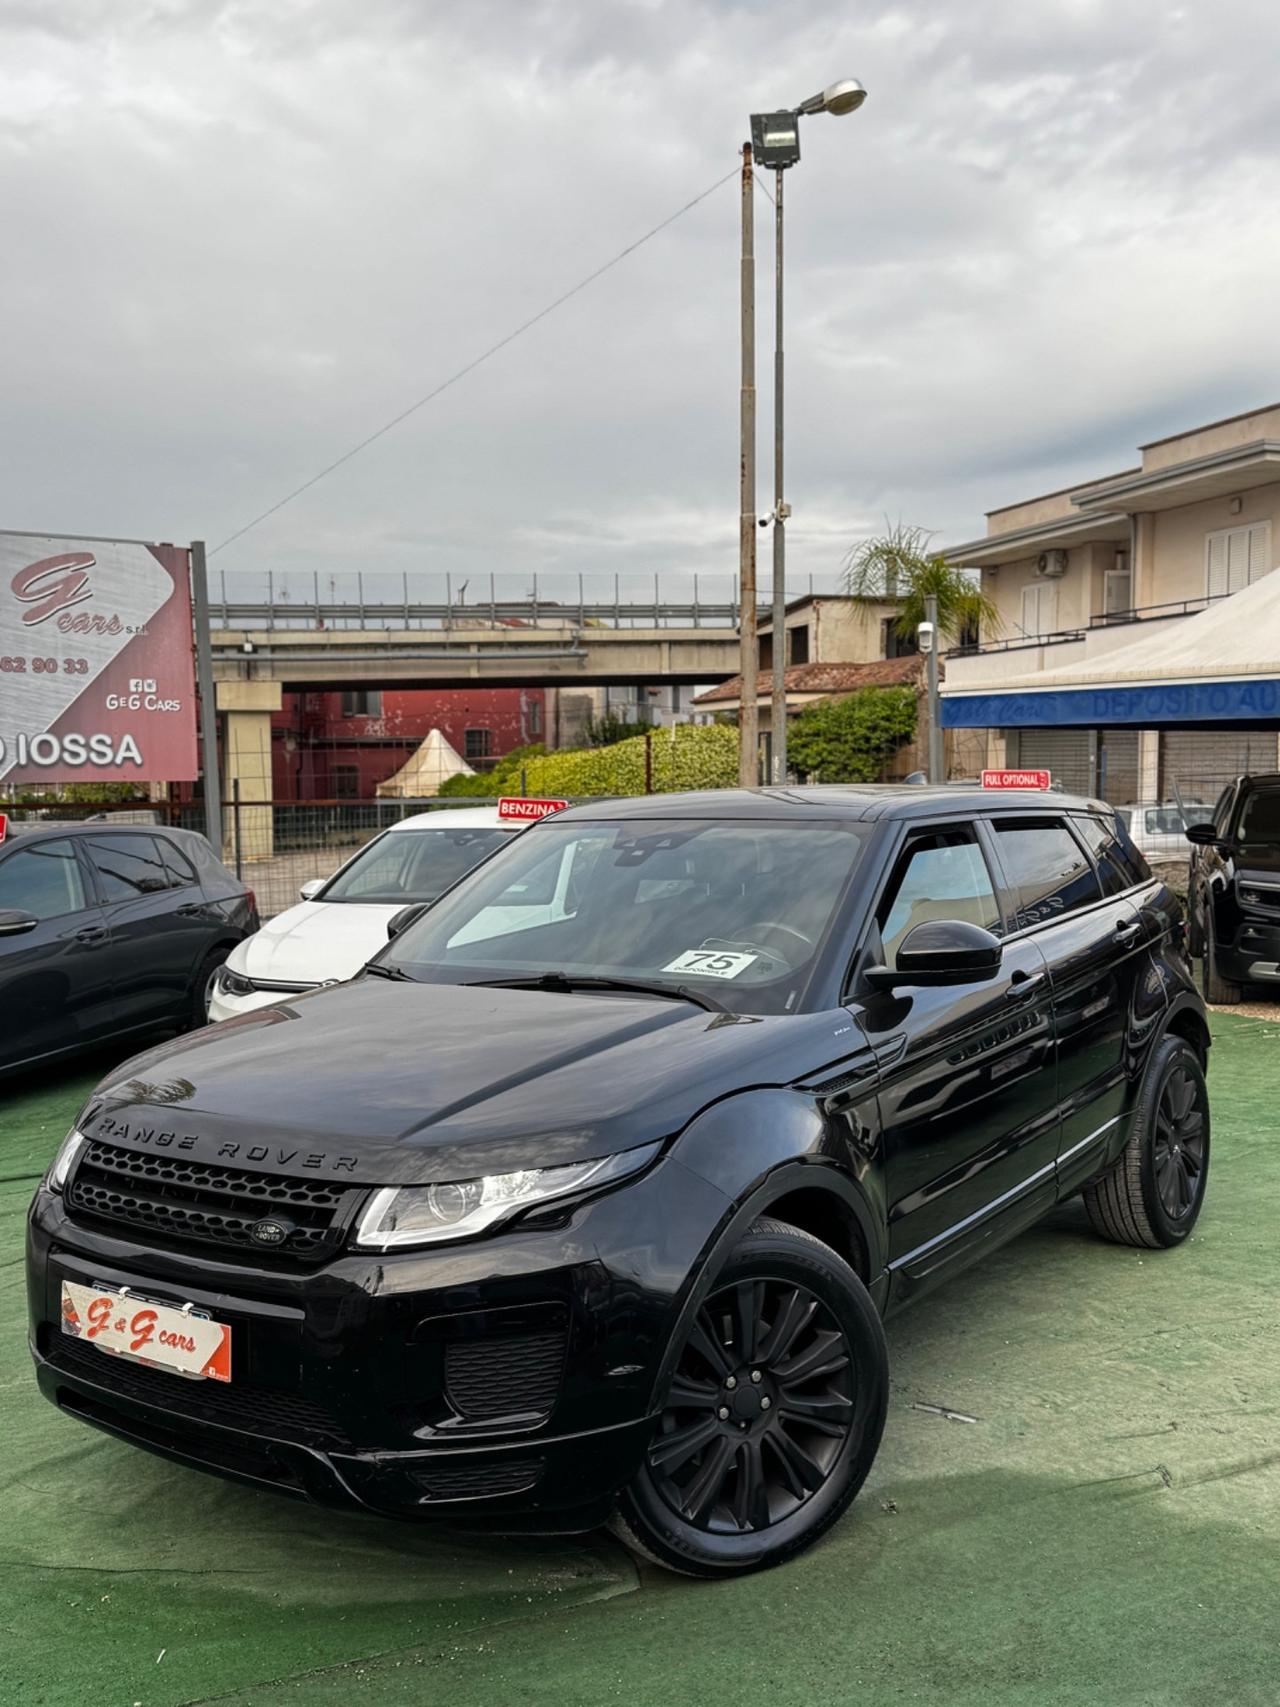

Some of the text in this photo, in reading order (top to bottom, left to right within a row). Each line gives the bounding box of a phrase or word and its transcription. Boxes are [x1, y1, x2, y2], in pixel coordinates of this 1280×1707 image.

[57, 612, 124, 635] cars
[32, 657, 58, 674] 90
[63, 658, 89, 675] 33
[1092, 687, 1229, 716] DEPOSITO
[17, 732, 143, 766] IOSSA
[985, 774, 1002, 785] FULL
[1003, 774, 1038, 785] OPTIONAL
[501, 802, 556, 816] BENZINA
[684, 953, 741, 970] 75
[99, 1117, 359, 1172] RANGE ROVER
[258, 1225, 276, 1233] LAND
[259, 1232, 280, 1241] ROVER
[158, 1328, 196, 1352] cars
